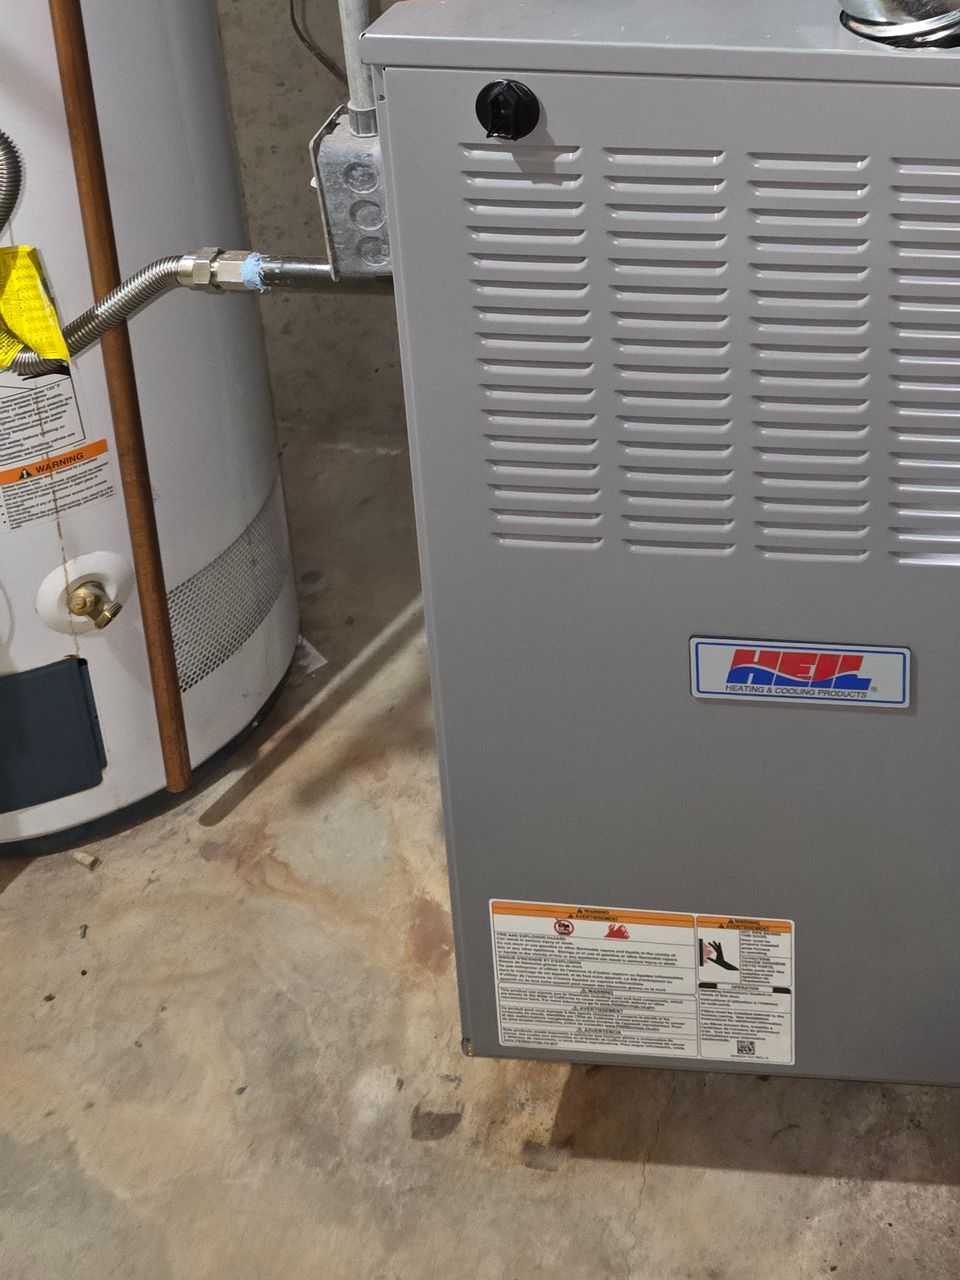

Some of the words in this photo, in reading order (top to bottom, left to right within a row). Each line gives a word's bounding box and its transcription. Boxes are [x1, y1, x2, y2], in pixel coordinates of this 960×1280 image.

[35, 452, 84, 473] WARNING
[726, 649, 872, 690] HEIL
[725, 684, 765, 694] HEATING
[774, 686, 816, 696] COOLING
[817, 689, 868, 699] PRODUCTS
